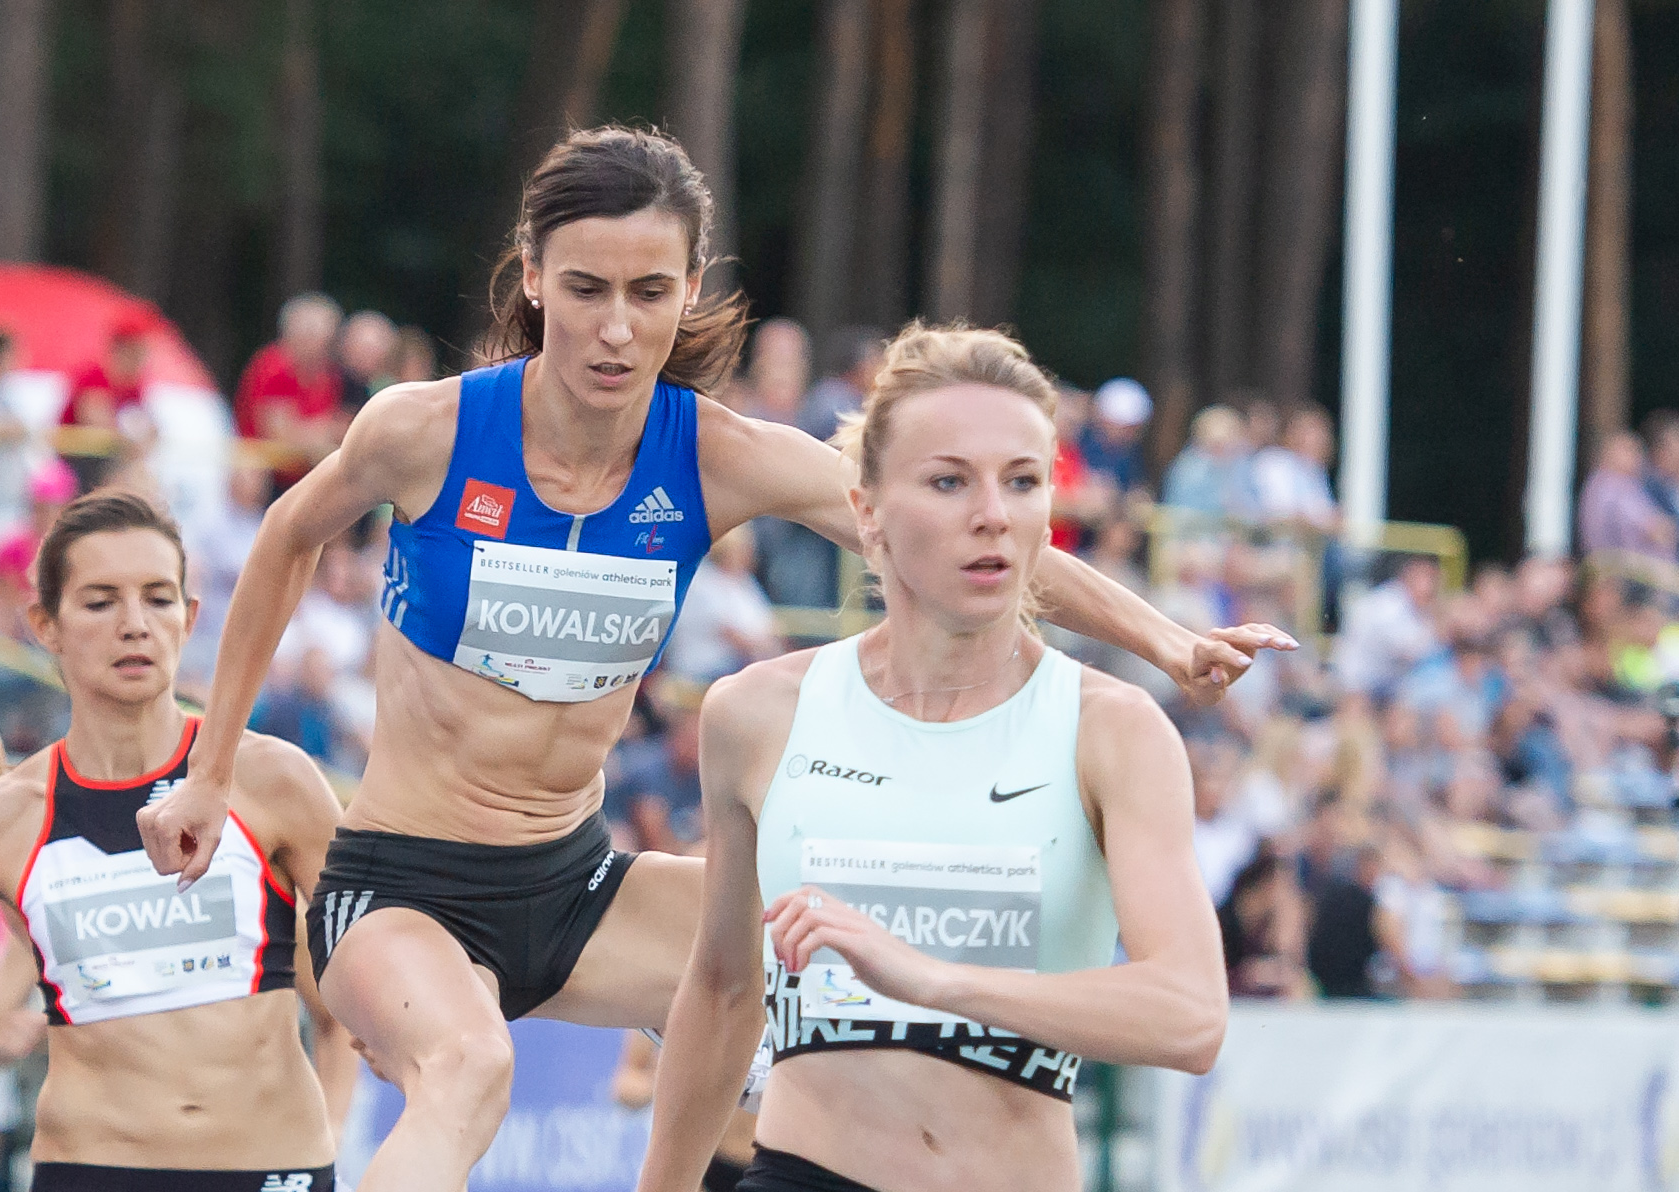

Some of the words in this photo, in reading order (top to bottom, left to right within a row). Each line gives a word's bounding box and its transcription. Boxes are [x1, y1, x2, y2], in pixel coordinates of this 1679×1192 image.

[629, 508, 685, 524] adidas
[480, 558, 550, 575] BESTSELLER
[553, 567, 600, 581] goleniów
[602, 573, 648, 586] athletics
[649, 577, 672, 589] park
[478, 599, 660, 646] KOWALSKA
[809, 759, 892, 787] Razor
[809, 856, 886, 870] BESTSELLER
[947, 863, 1003, 877] athletics
[1006, 866, 1037, 878] park
[74, 893, 212, 941] KOWAL
